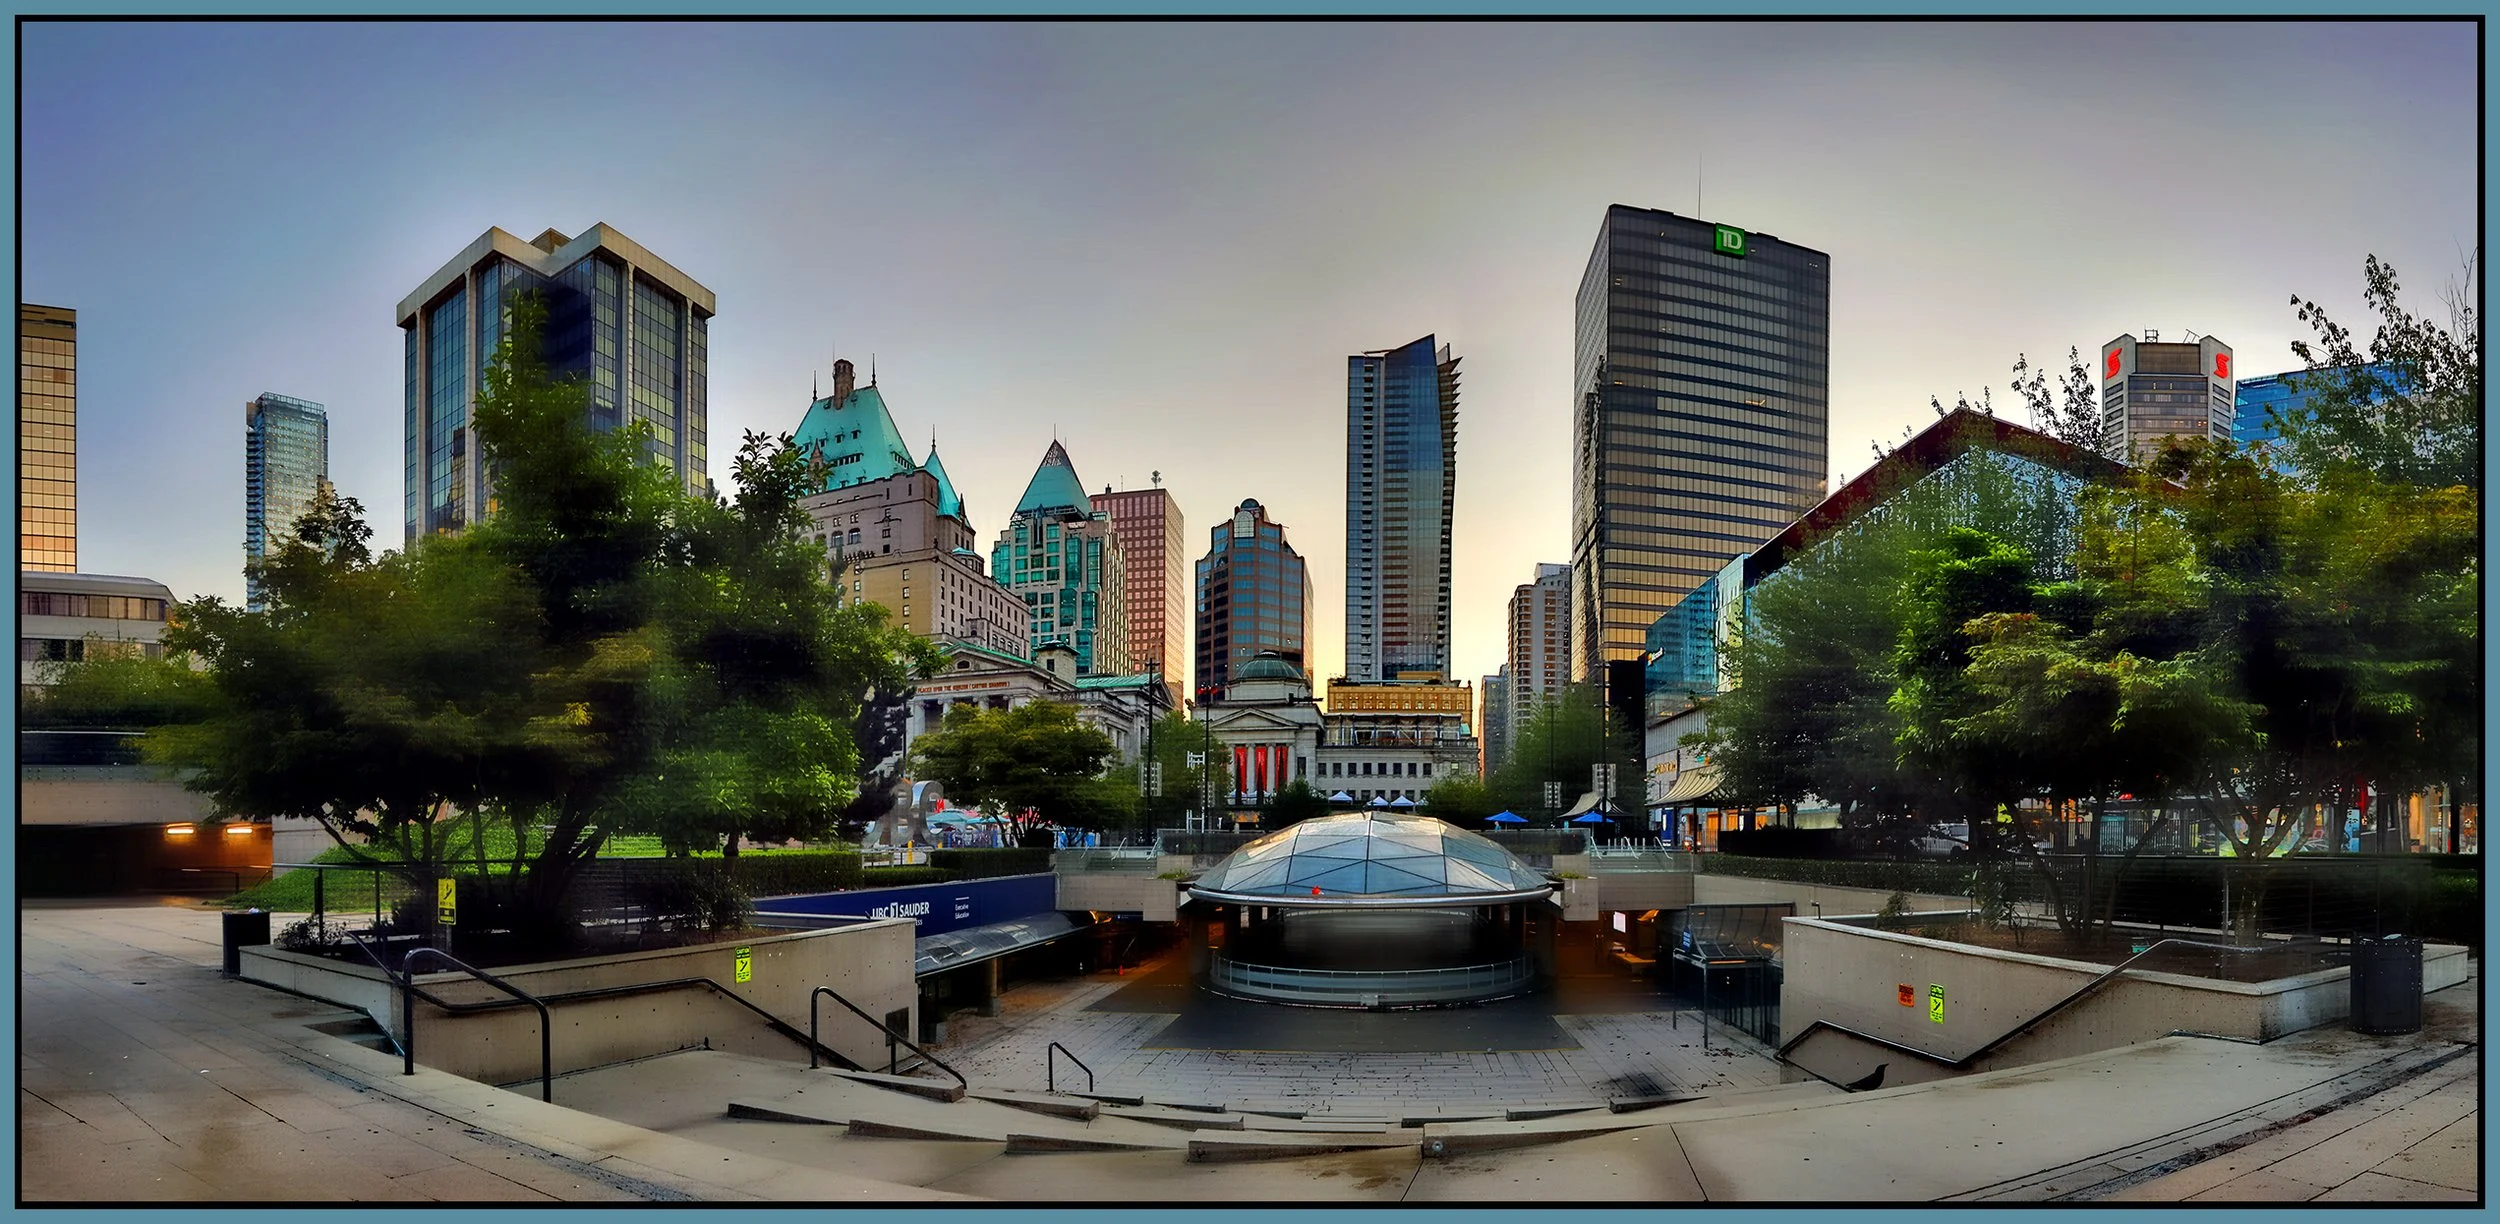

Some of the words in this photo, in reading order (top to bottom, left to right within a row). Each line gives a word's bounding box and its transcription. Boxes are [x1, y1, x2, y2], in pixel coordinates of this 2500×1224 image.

[1718, 228, 1742, 250] TD
[872, 906, 889, 918] UBC
[899, 901, 930, 918] SAUDER
